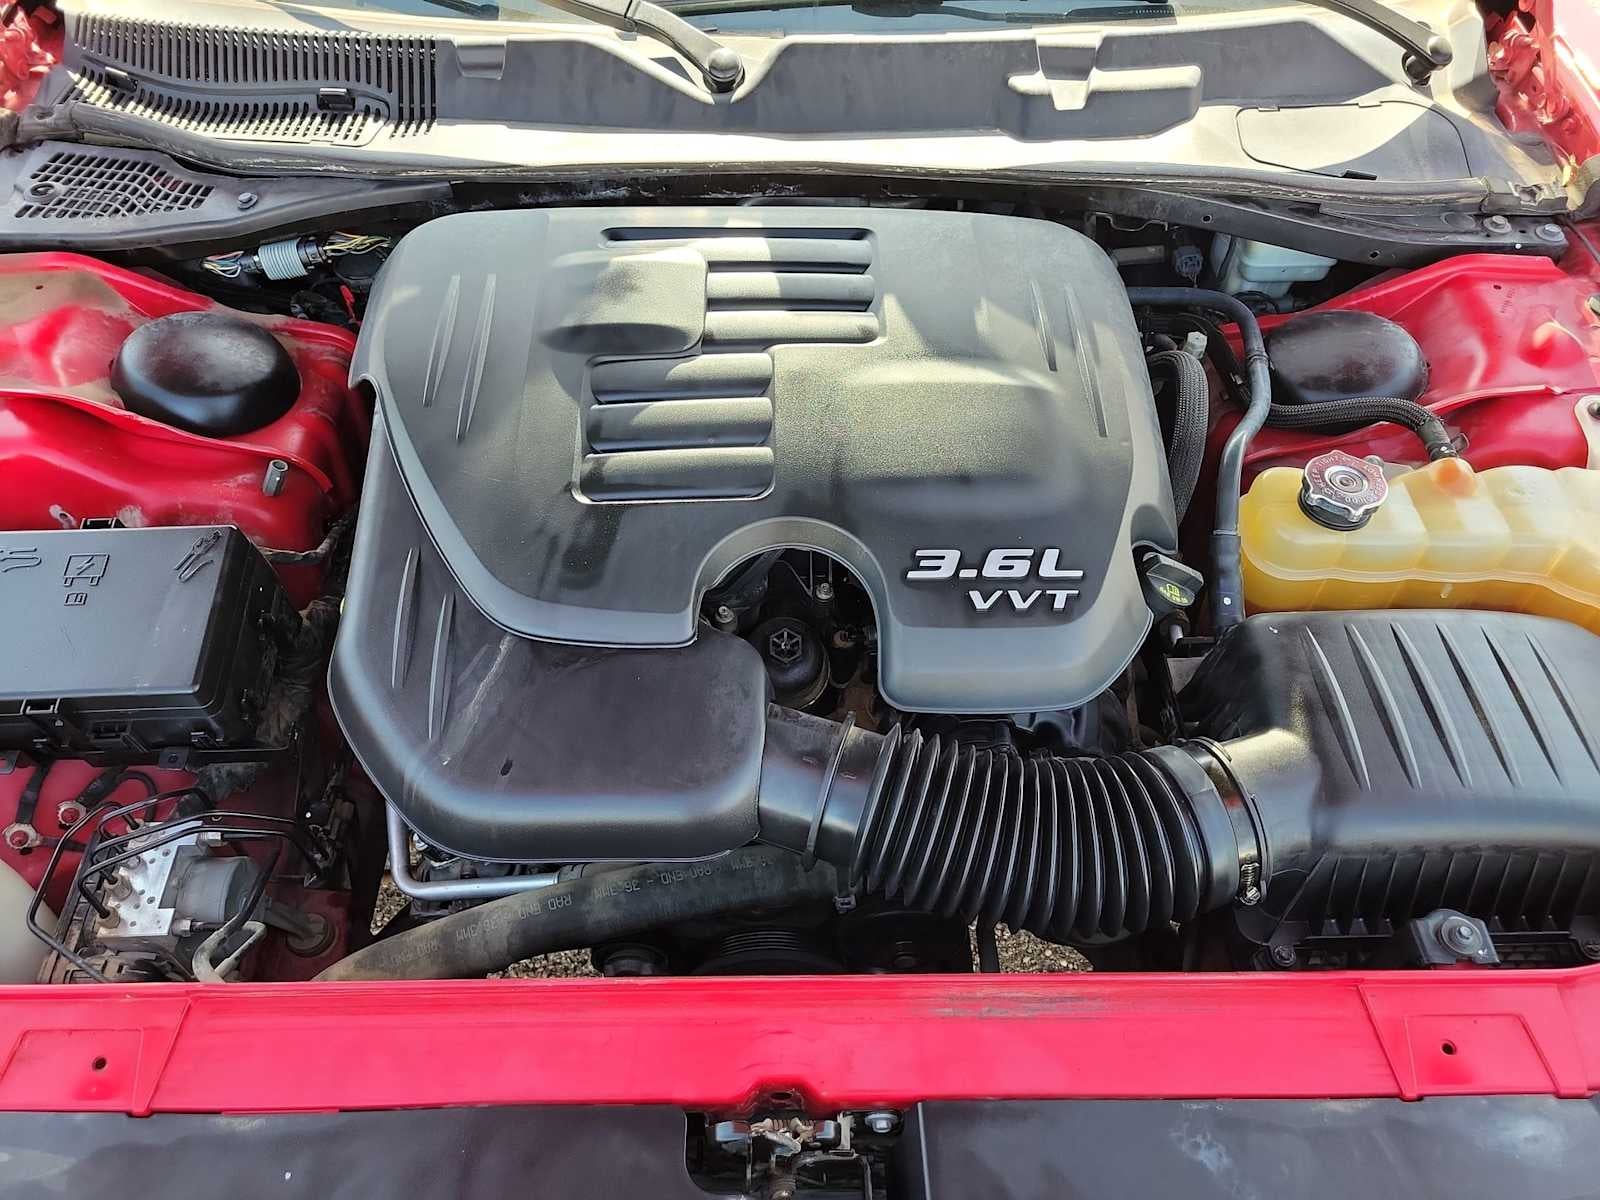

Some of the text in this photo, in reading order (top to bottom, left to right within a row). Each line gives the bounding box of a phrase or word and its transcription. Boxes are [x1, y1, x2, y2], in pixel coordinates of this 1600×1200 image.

[906, 548, 1084, 579] 3.6L
[968, 590, 1080, 611] VVT
[548, 894, 572, 912] RAD
